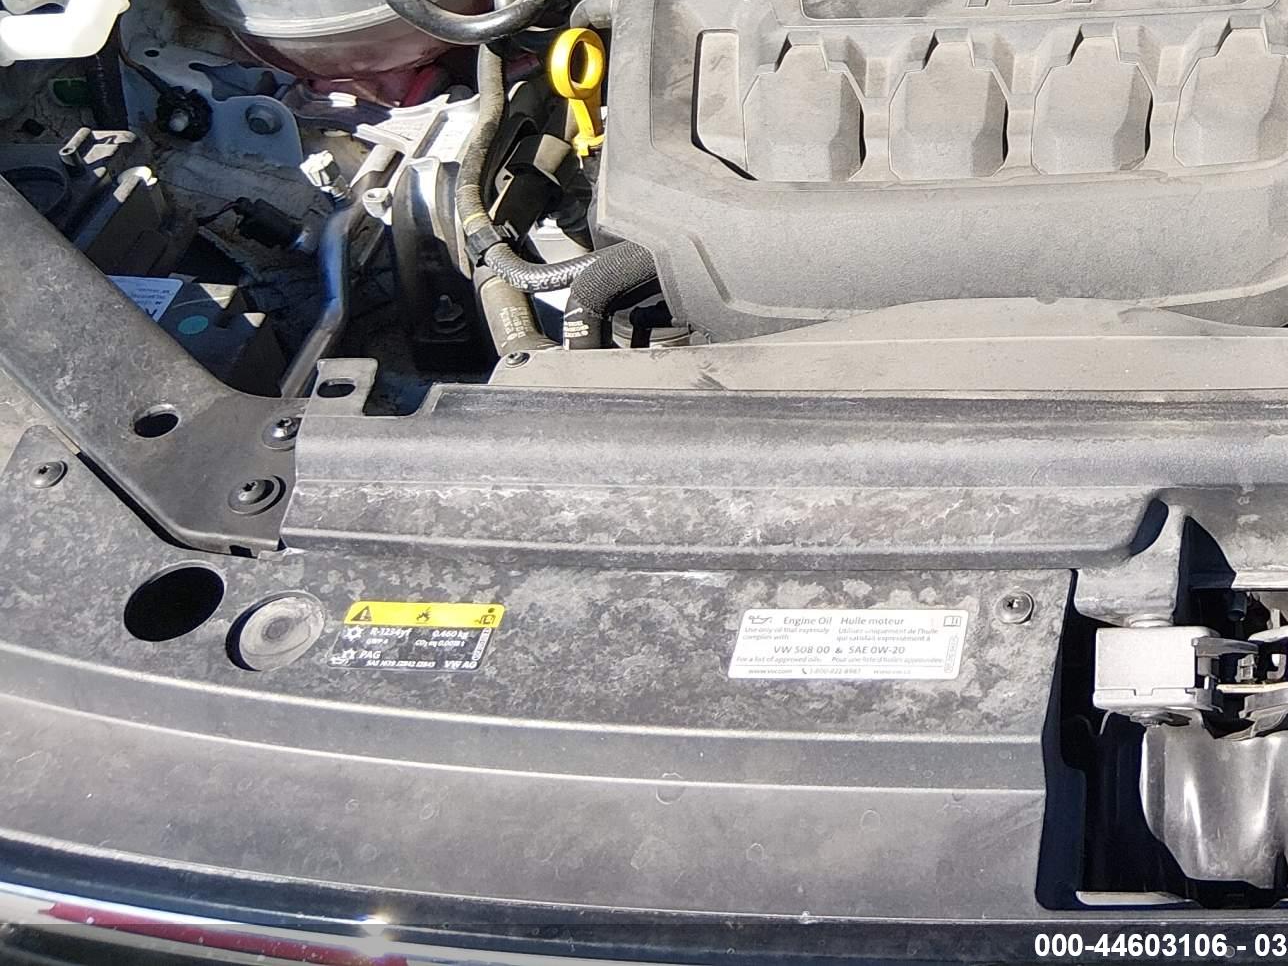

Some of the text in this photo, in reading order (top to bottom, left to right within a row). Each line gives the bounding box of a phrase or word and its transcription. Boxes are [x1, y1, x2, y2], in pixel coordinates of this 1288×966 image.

[783, 616, 832, 626] Engine Oil
[841, 617, 866, 625] Huile
[774, 646, 793, 654] VW
[794, 646, 814, 654] 508
[816, 646, 830, 654] 00
[848, 646, 870, 654] SAE
[870, 646, 906, 654] 0W-20
[359, 650, 382, 660] PAG
[444, 660, 463, 669] VW
